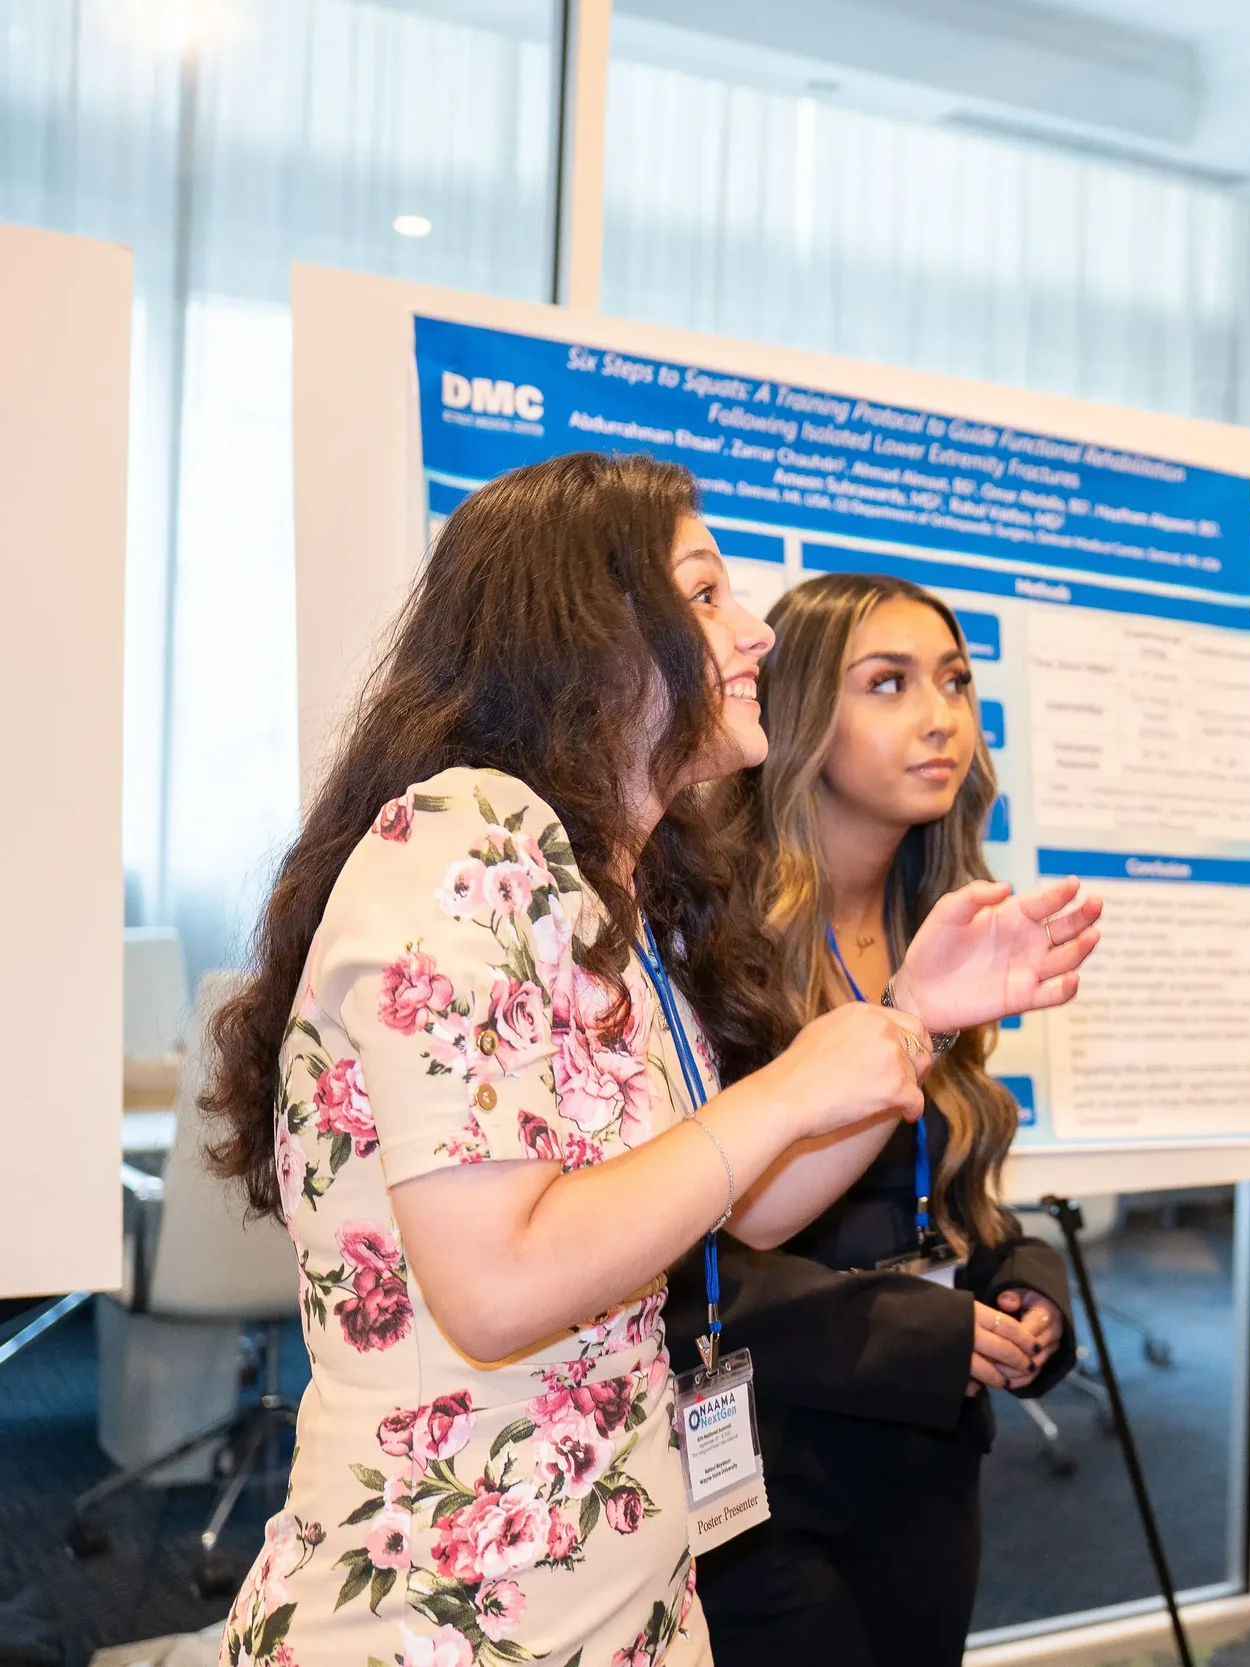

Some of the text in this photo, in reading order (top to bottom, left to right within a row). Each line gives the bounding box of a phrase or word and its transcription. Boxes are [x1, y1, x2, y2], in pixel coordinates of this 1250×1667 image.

[441, 370, 544, 421] DMC
[566, 345, 596, 371] Six
[602, 351, 655, 385] Steps
[658, 367, 679, 386] to
[754, 382, 769, 402] A
[777, 385, 849, 422] Training
[852, 399, 926, 431] Protocol
[926, 414, 946, 436] to
[948, 418, 999, 445] Guide
[1000, 429, 1082, 461] Functional
[709, 403, 796, 441] Following
[802, 423, 870, 449] Isolated
[874, 436, 924, 458] Lower
[929, 443, 1003, 476] Extremity
[1015, 577, 1072, 604] Methods
[700, 1392, 736, 1416] NAAMA
[700, 1405, 737, 1429] NextGen
[700, 1474, 712, 1485] Wayne
[721, 1463, 738, 1474] University
[697, 1495, 758, 1534] Poster Presenter
